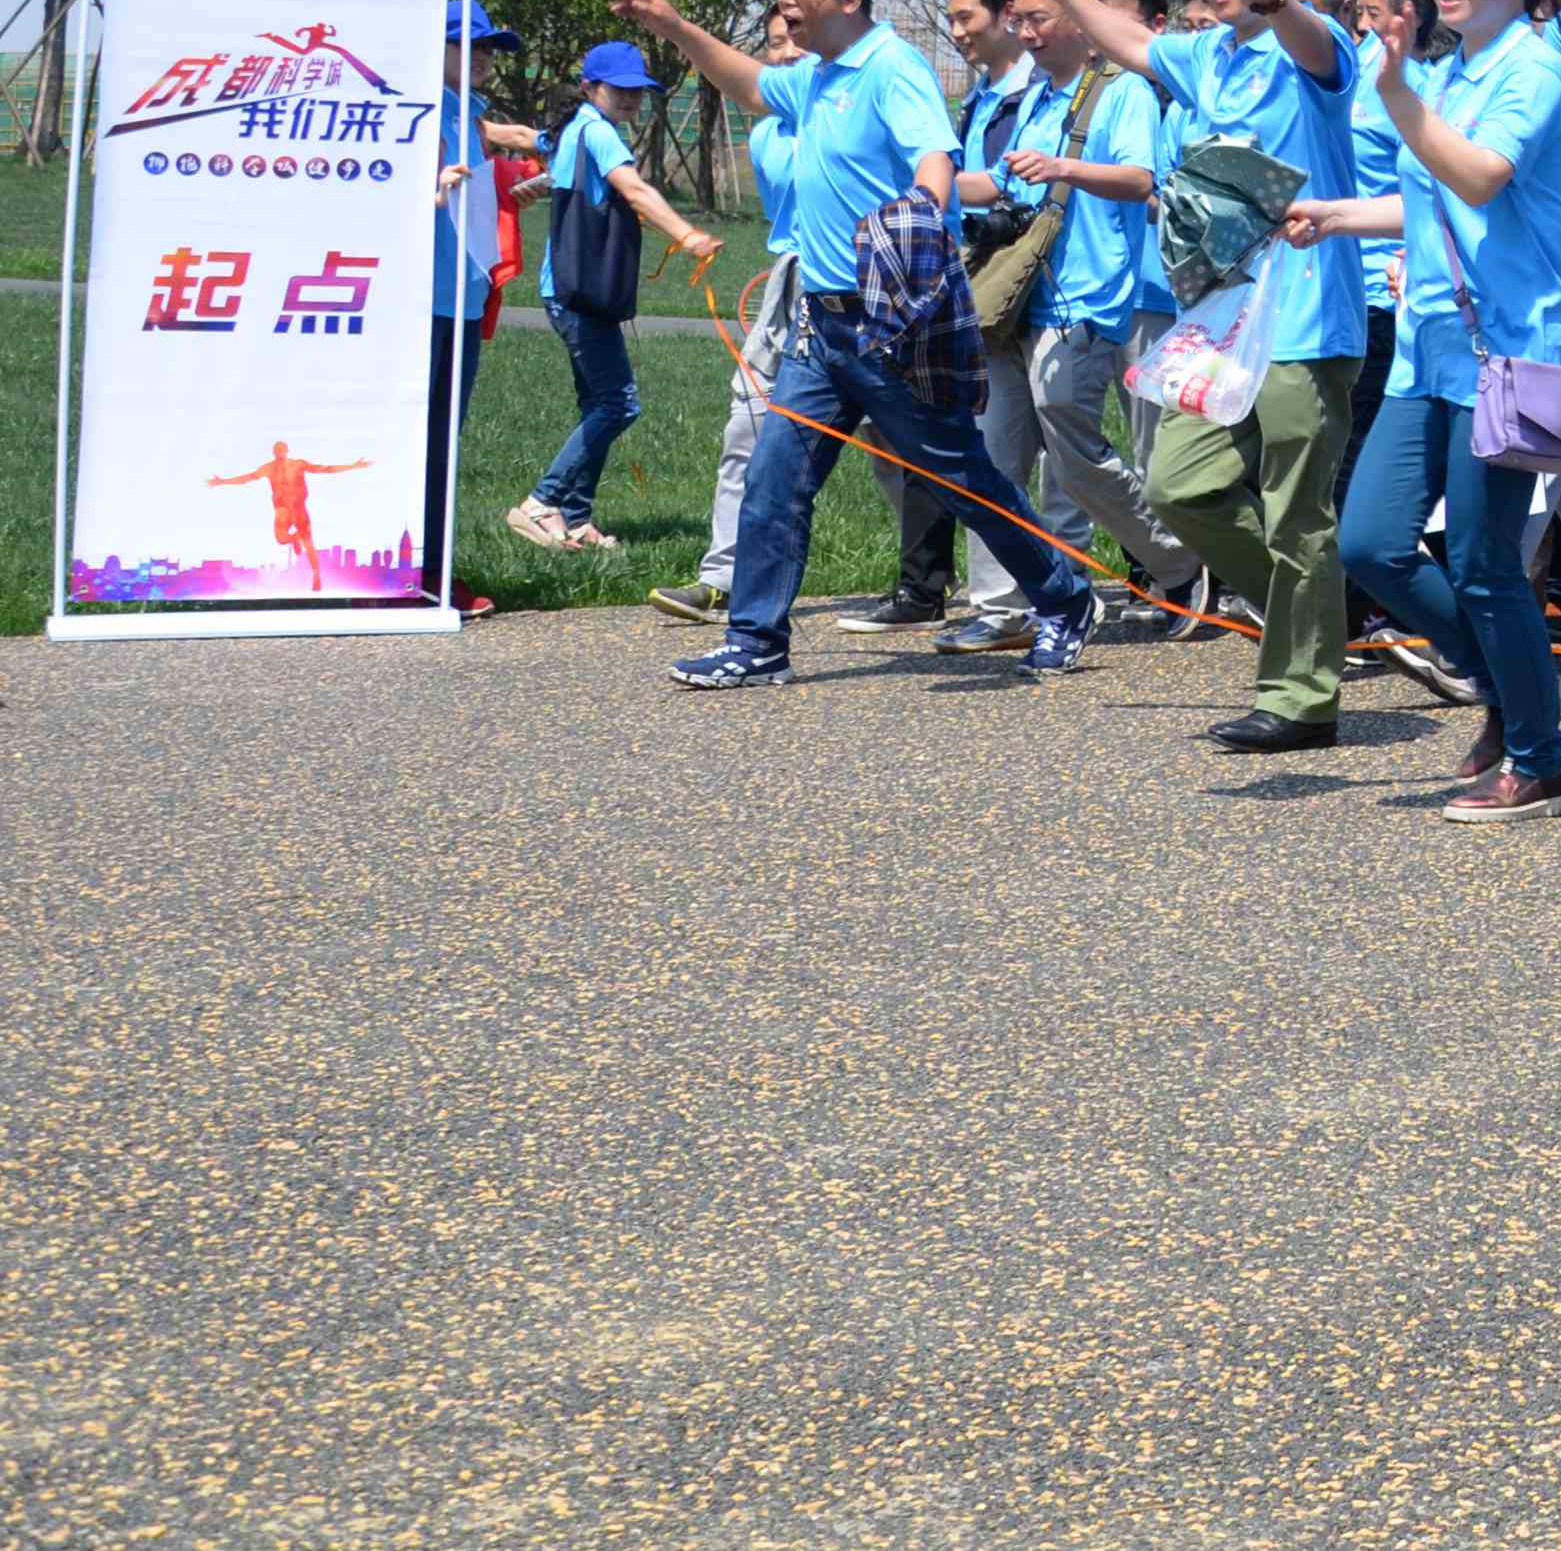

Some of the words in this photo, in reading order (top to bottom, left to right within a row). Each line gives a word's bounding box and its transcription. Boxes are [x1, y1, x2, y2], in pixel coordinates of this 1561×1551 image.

[123, 53, 344, 114] 成都科学城
[238, 98, 436, 143] 我们来了
[141, 246, 381, 335] 起点
